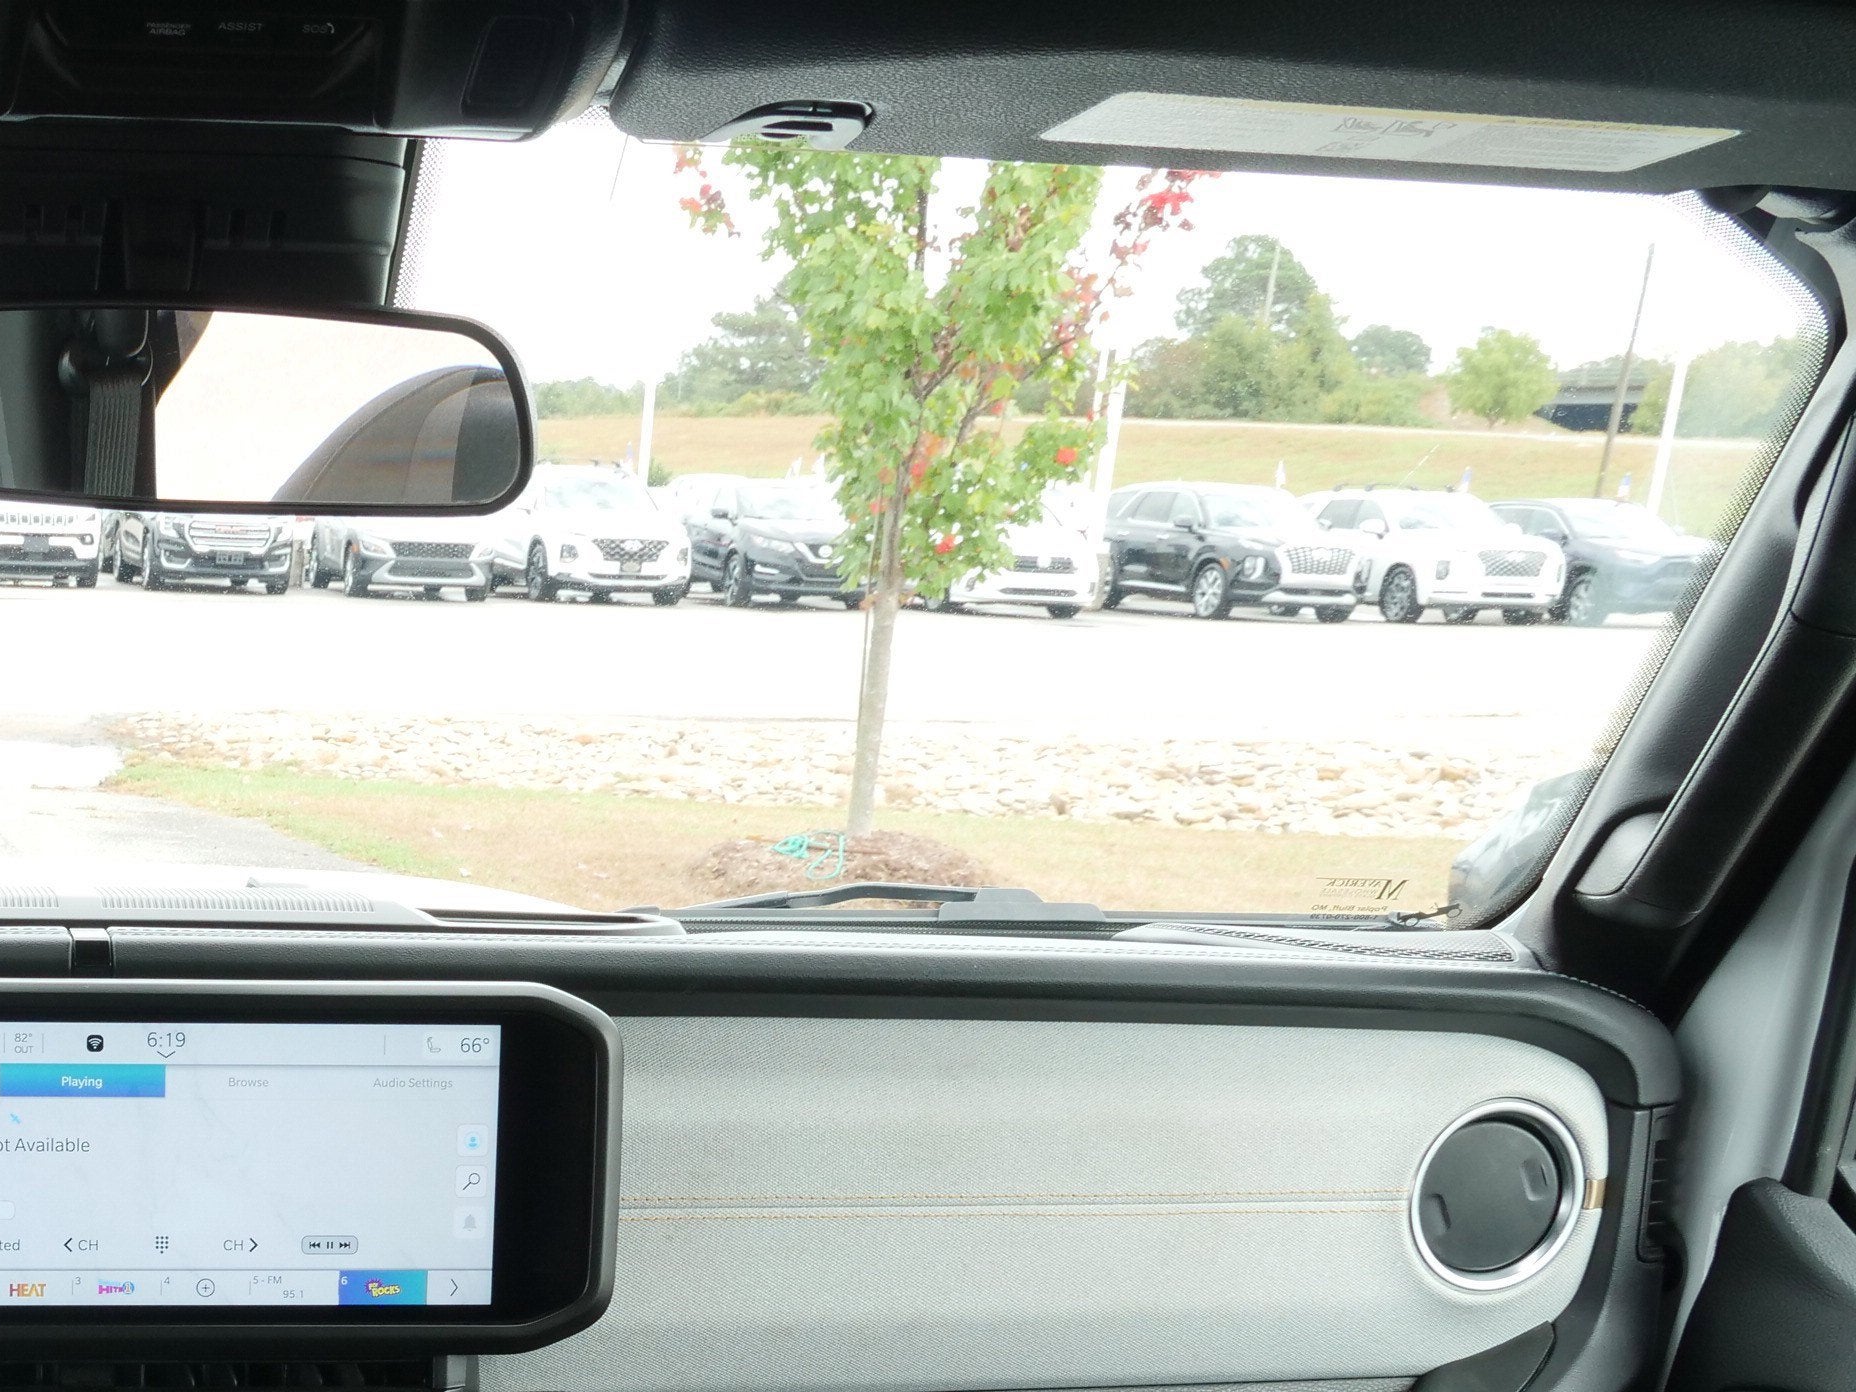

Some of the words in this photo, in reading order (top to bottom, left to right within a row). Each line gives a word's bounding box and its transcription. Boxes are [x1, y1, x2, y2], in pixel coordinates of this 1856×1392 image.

[148, 28, 186, 37] AIRBAG
[217, 22, 263, 32] ASSIST
[303, 24, 327, 34] SOS
[14, 1032, 33, 1044] 82°
[146, 1032, 186, 1048] 6:19
[14, 1045, 34, 1054] OUT
[460, 1037, 490, 1053] 66°
[60, 1076, 103, 1090] Playing
[228, 1077, 269, 1088] Browse
[373, 1078, 406, 1089] Audio
[408, 1077, 453, 1091] Settings
[14, 1136, 91, 1153] Available
[77, 1240, 100, 1252] CH
[222, 1240, 244, 1251] CH
[75, 1276, 82, 1285] 3
[164, 1276, 170, 1285] 4
[252, 1276, 259, 1284] 5
[267, 1276, 282, 1284] FM
[341, 1276, 348, 1286] 6
[9, 1283, 46, 1297] HEAT
[372, 1285, 400, 1297] ROCKS
